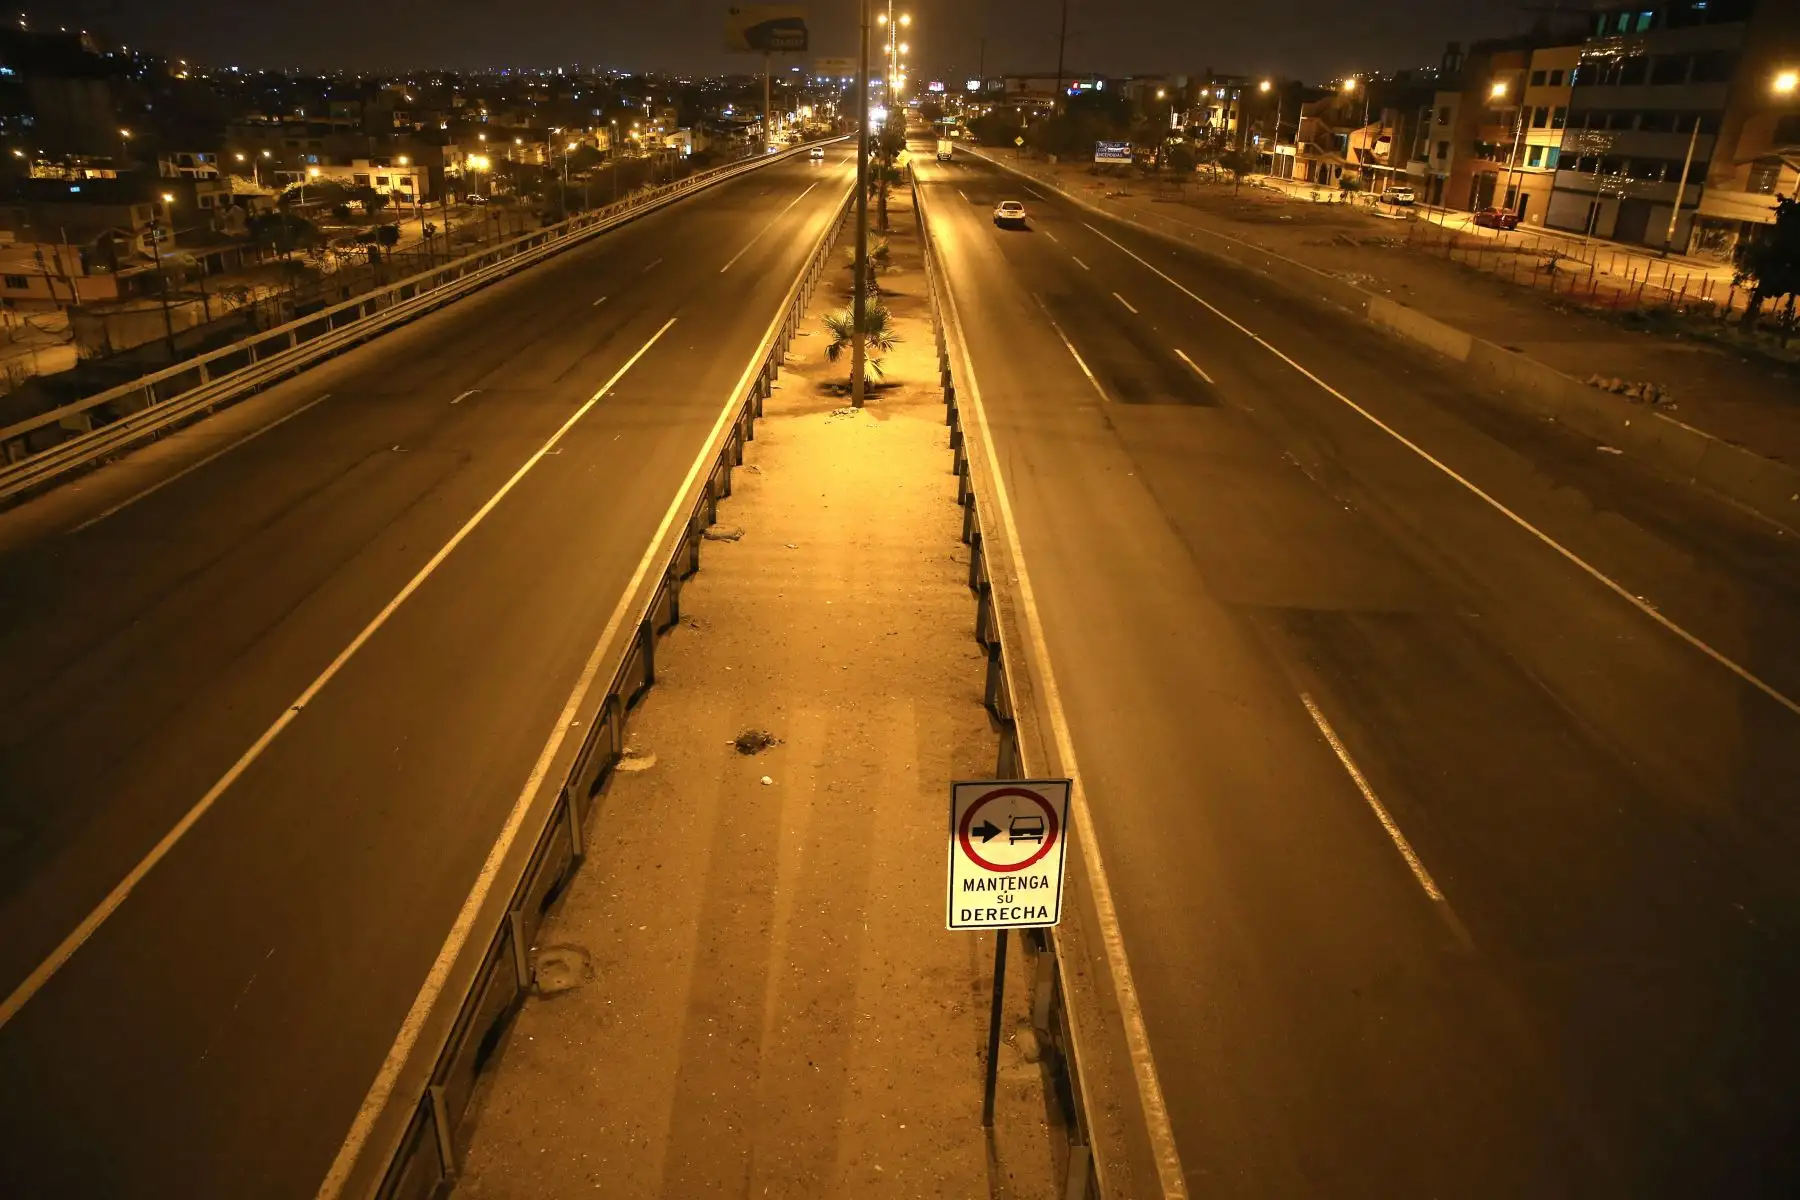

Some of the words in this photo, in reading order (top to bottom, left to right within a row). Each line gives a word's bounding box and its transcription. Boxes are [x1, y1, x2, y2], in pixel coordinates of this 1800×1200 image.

[963, 875, 1049, 892] MANTENGA
[997, 894, 1013, 904] SU
[961, 905, 1048, 922] DERECHA
